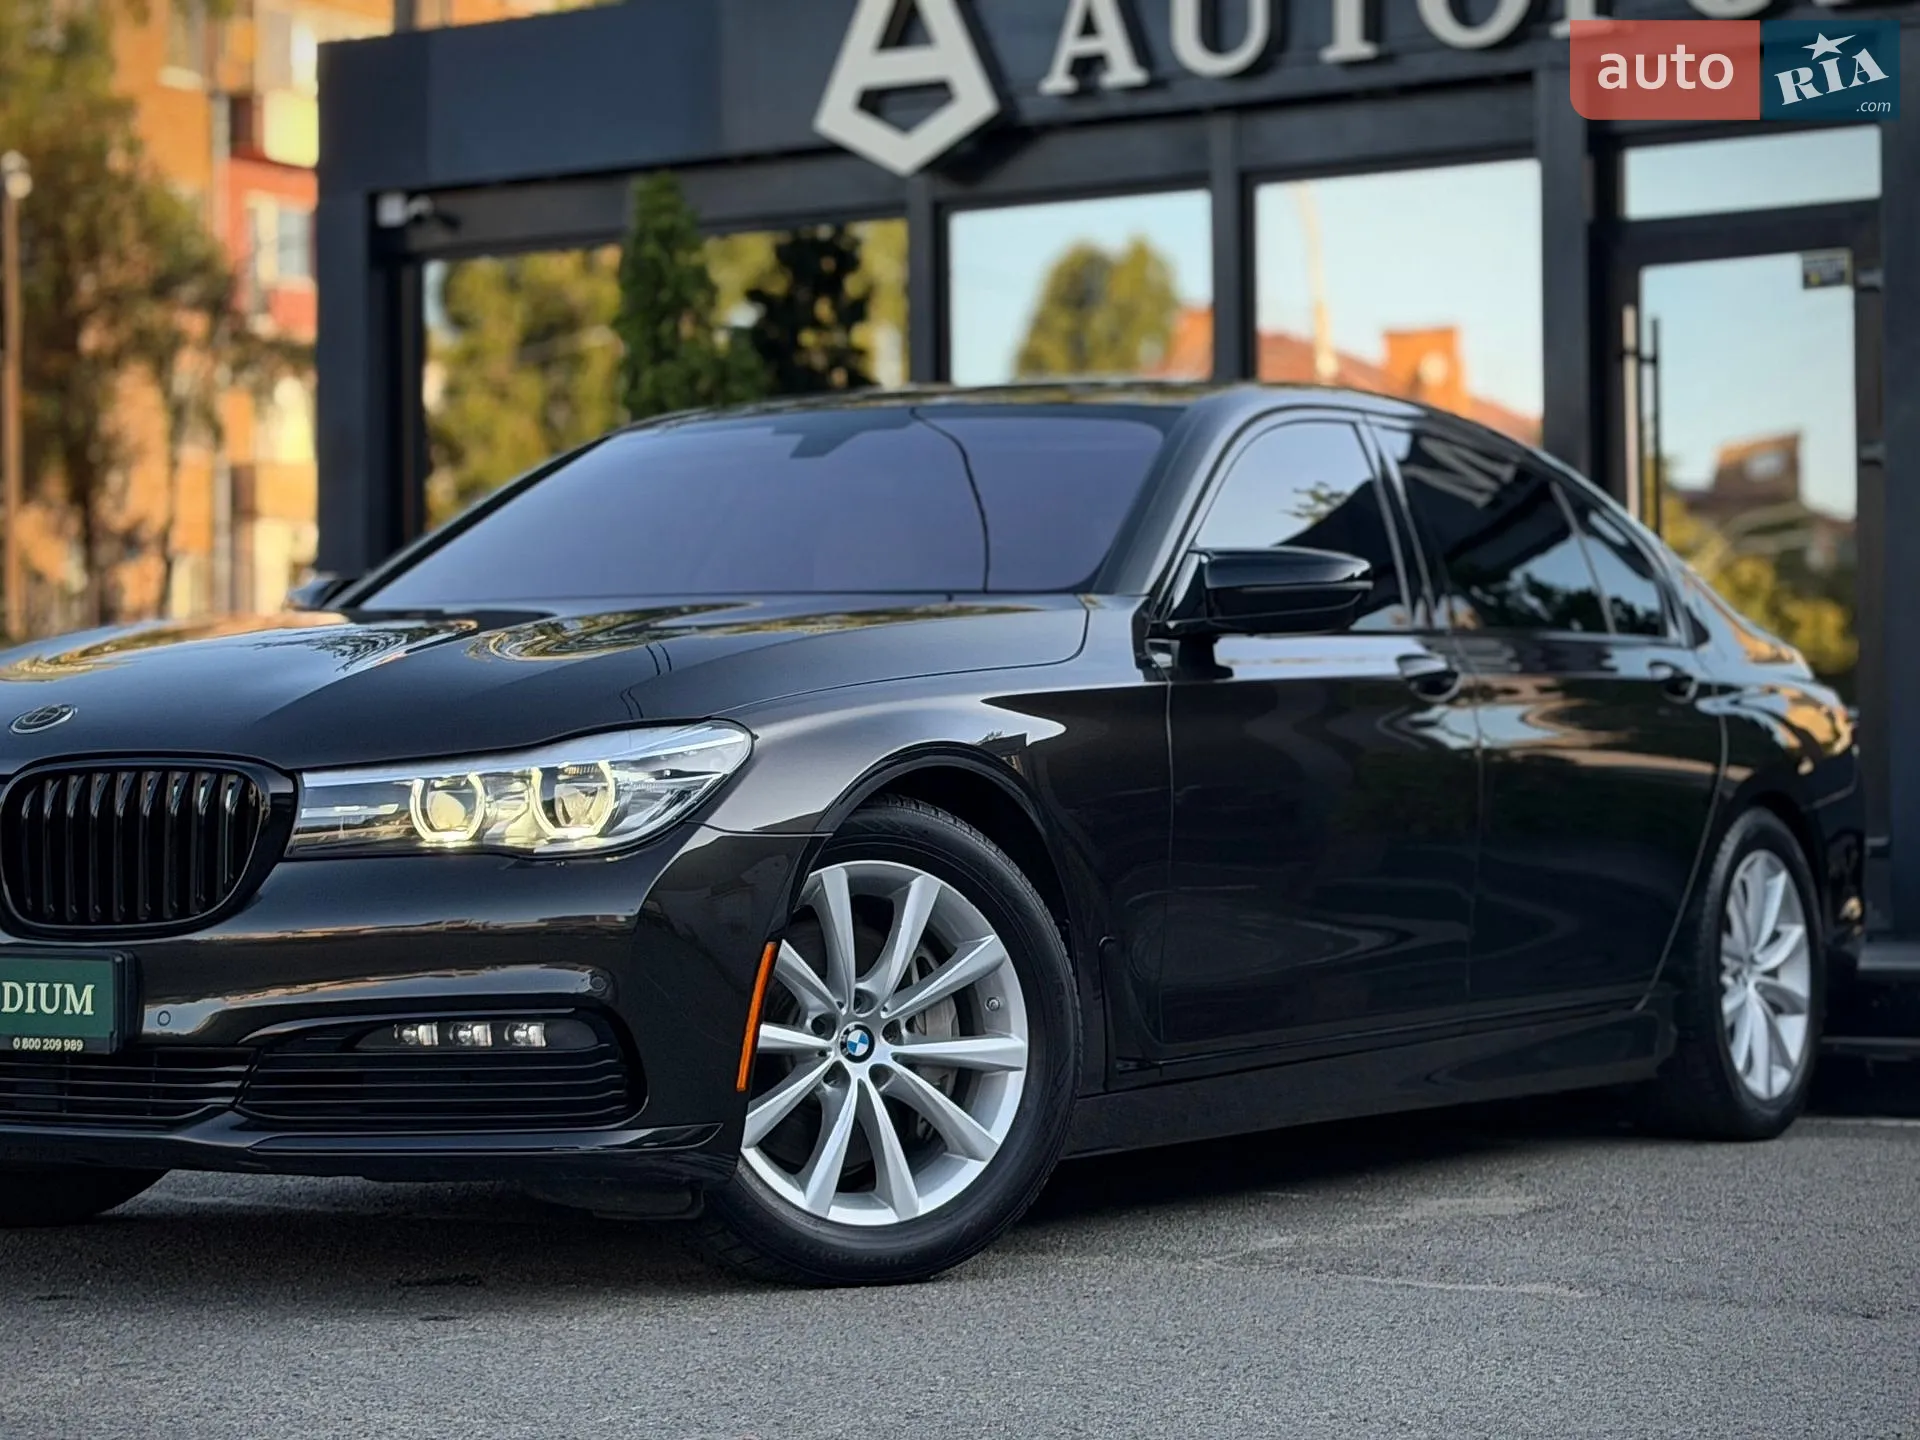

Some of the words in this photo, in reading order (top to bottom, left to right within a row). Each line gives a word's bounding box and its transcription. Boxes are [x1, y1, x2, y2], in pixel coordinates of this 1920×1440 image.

[1, 982, 95, 1015] DIUM
[13, 1037, 20, 1049] 0
[22, 1037, 41, 1050] 800
[43, 1038, 62, 1051] 209
[64, 1039, 83, 1051] 989
